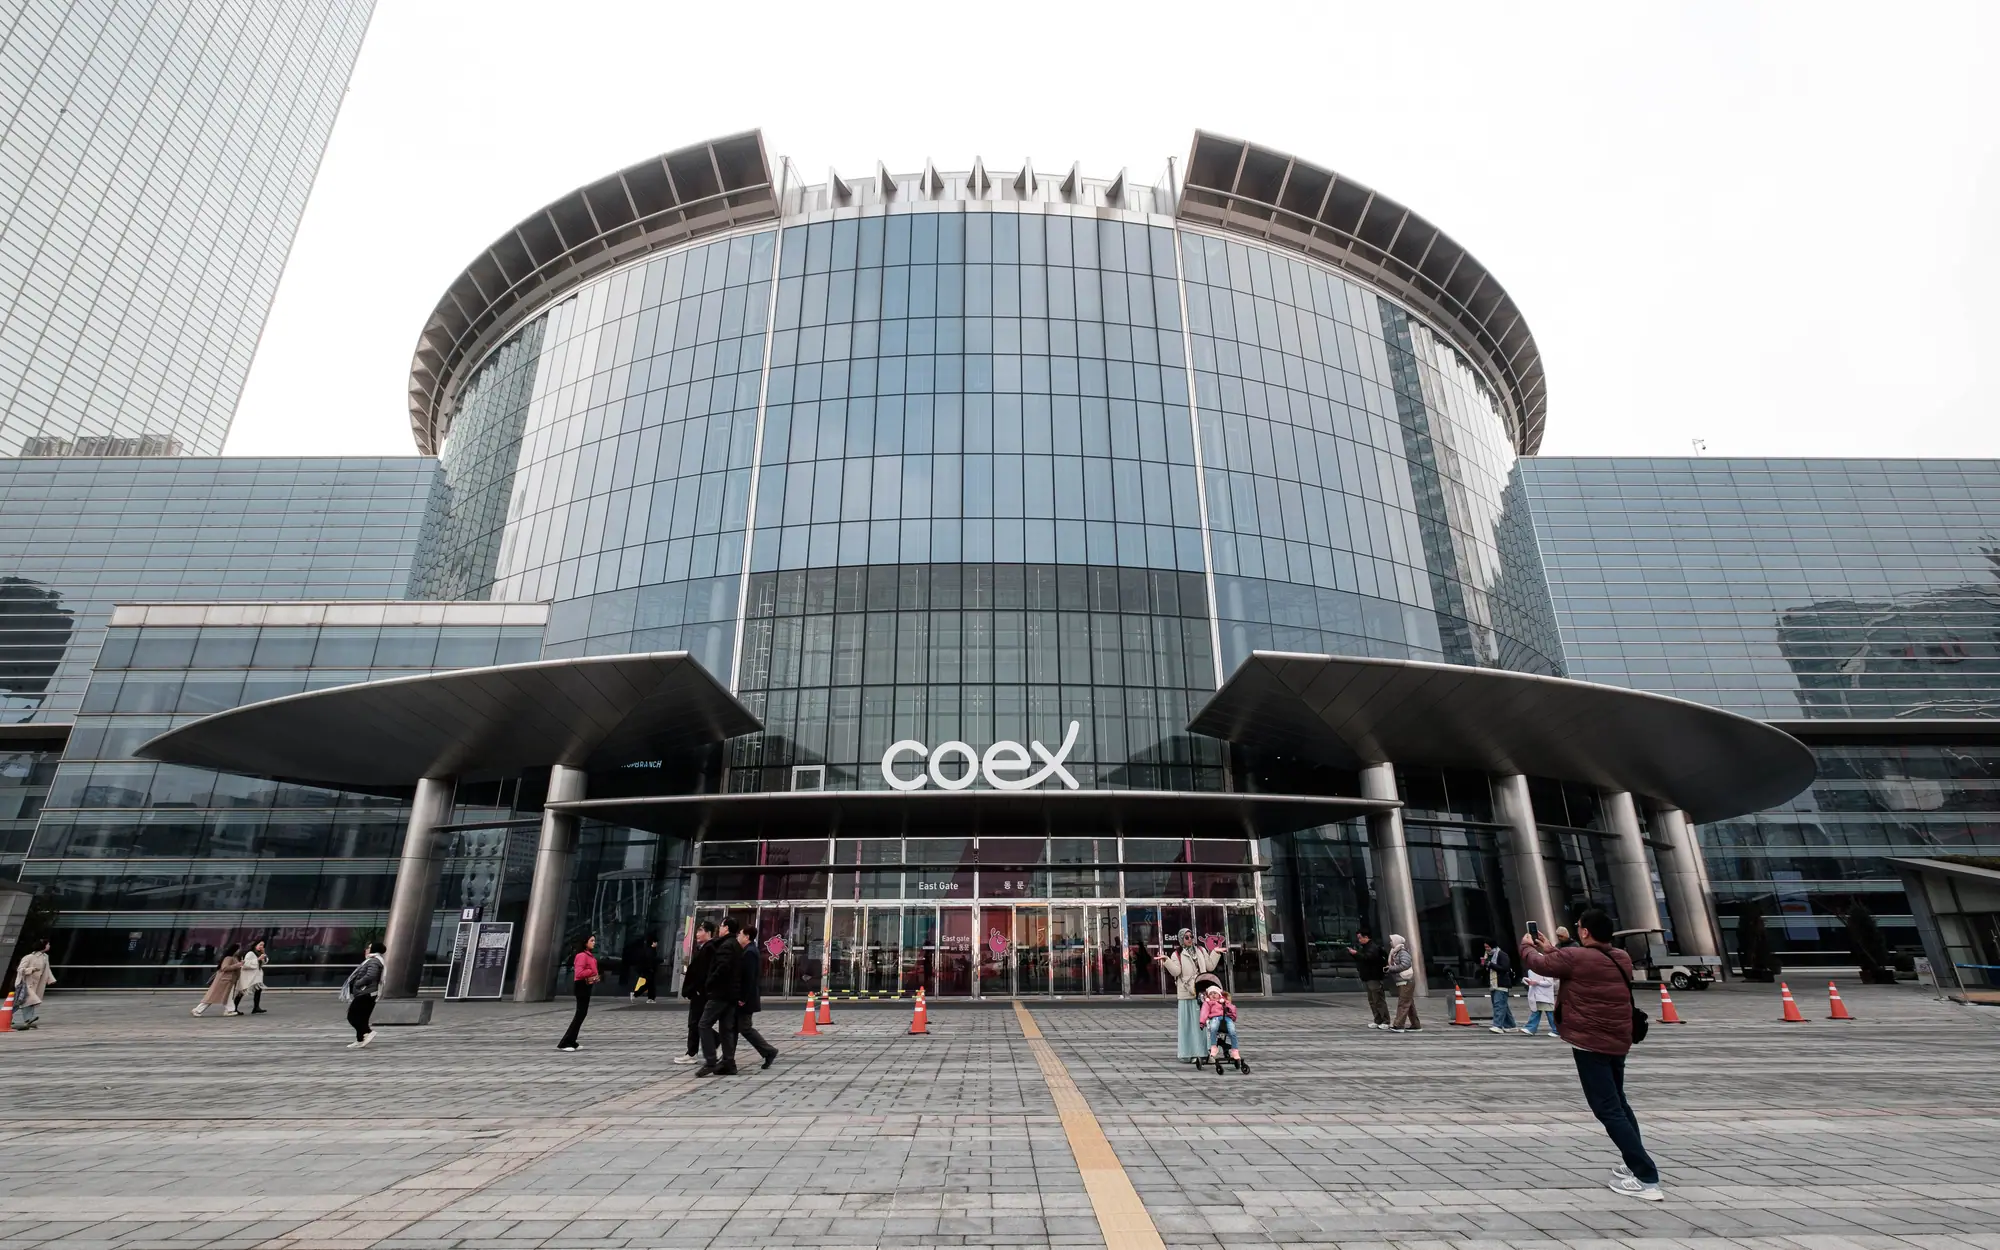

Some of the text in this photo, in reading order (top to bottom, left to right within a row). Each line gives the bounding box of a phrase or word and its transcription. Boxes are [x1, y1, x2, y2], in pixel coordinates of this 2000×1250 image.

[881, 720, 1080, 790] coex
[918, 882, 959, 890] East Gate
